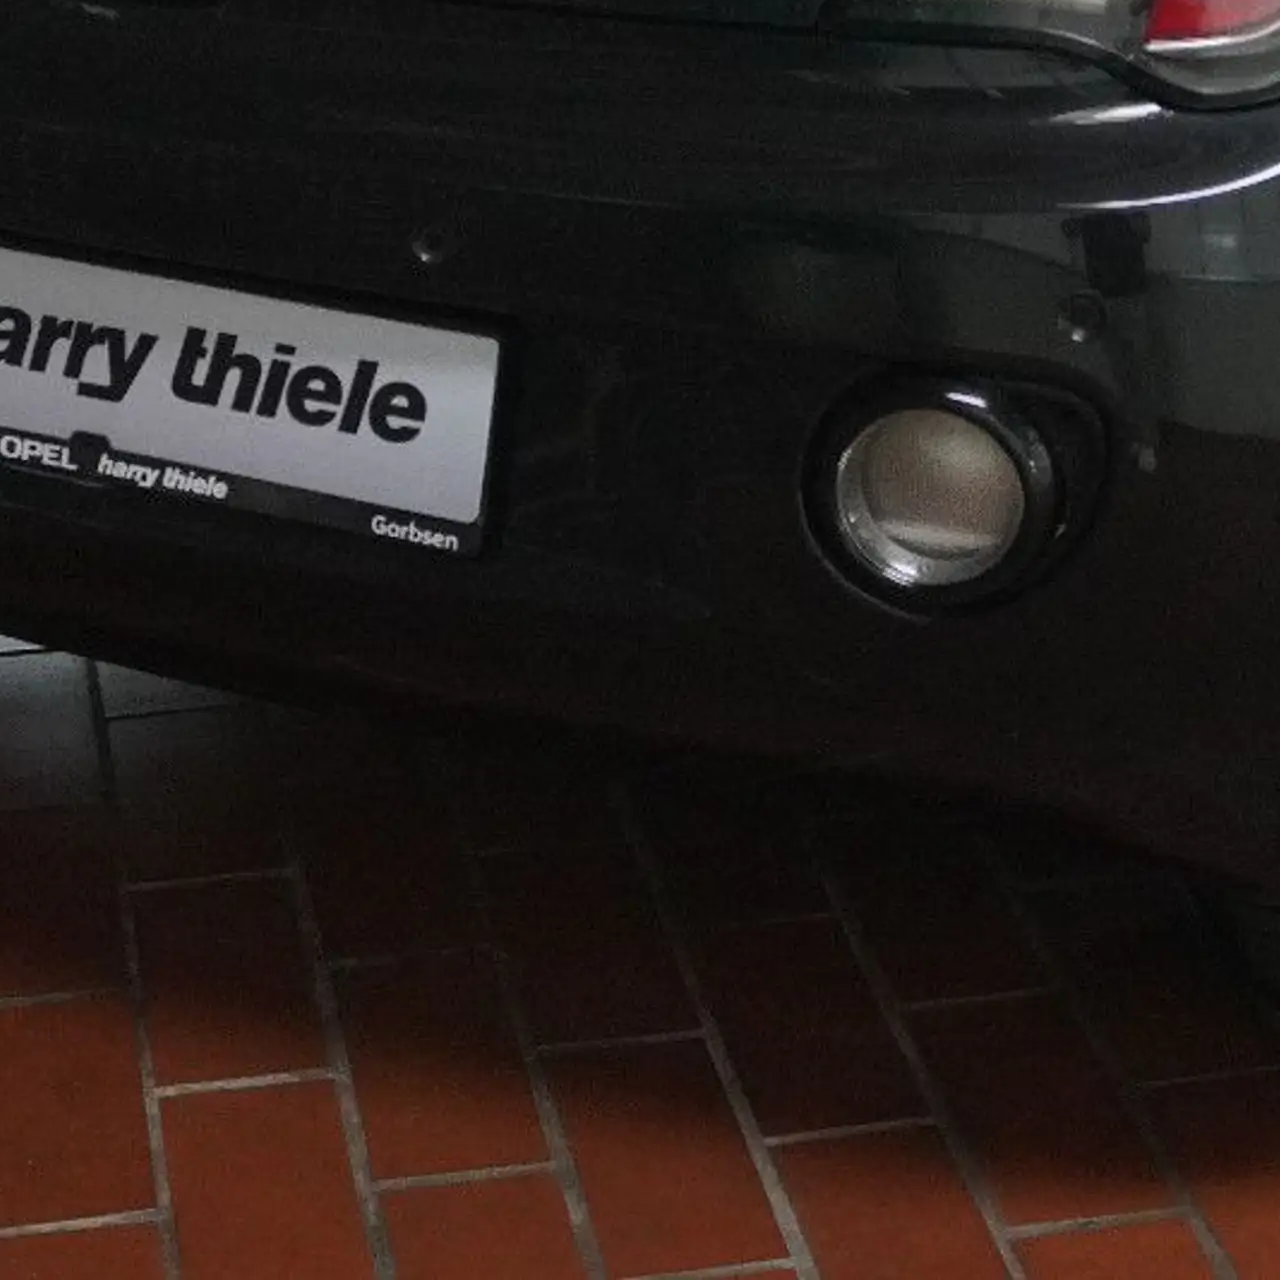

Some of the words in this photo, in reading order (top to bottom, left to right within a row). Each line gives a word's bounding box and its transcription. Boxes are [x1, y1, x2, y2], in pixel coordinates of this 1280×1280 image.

[171, 326, 427, 443] thiele
[0, 434, 79, 470] OPEL
[97, 453, 160, 488] harry
[162, 466, 228, 500] thiele
